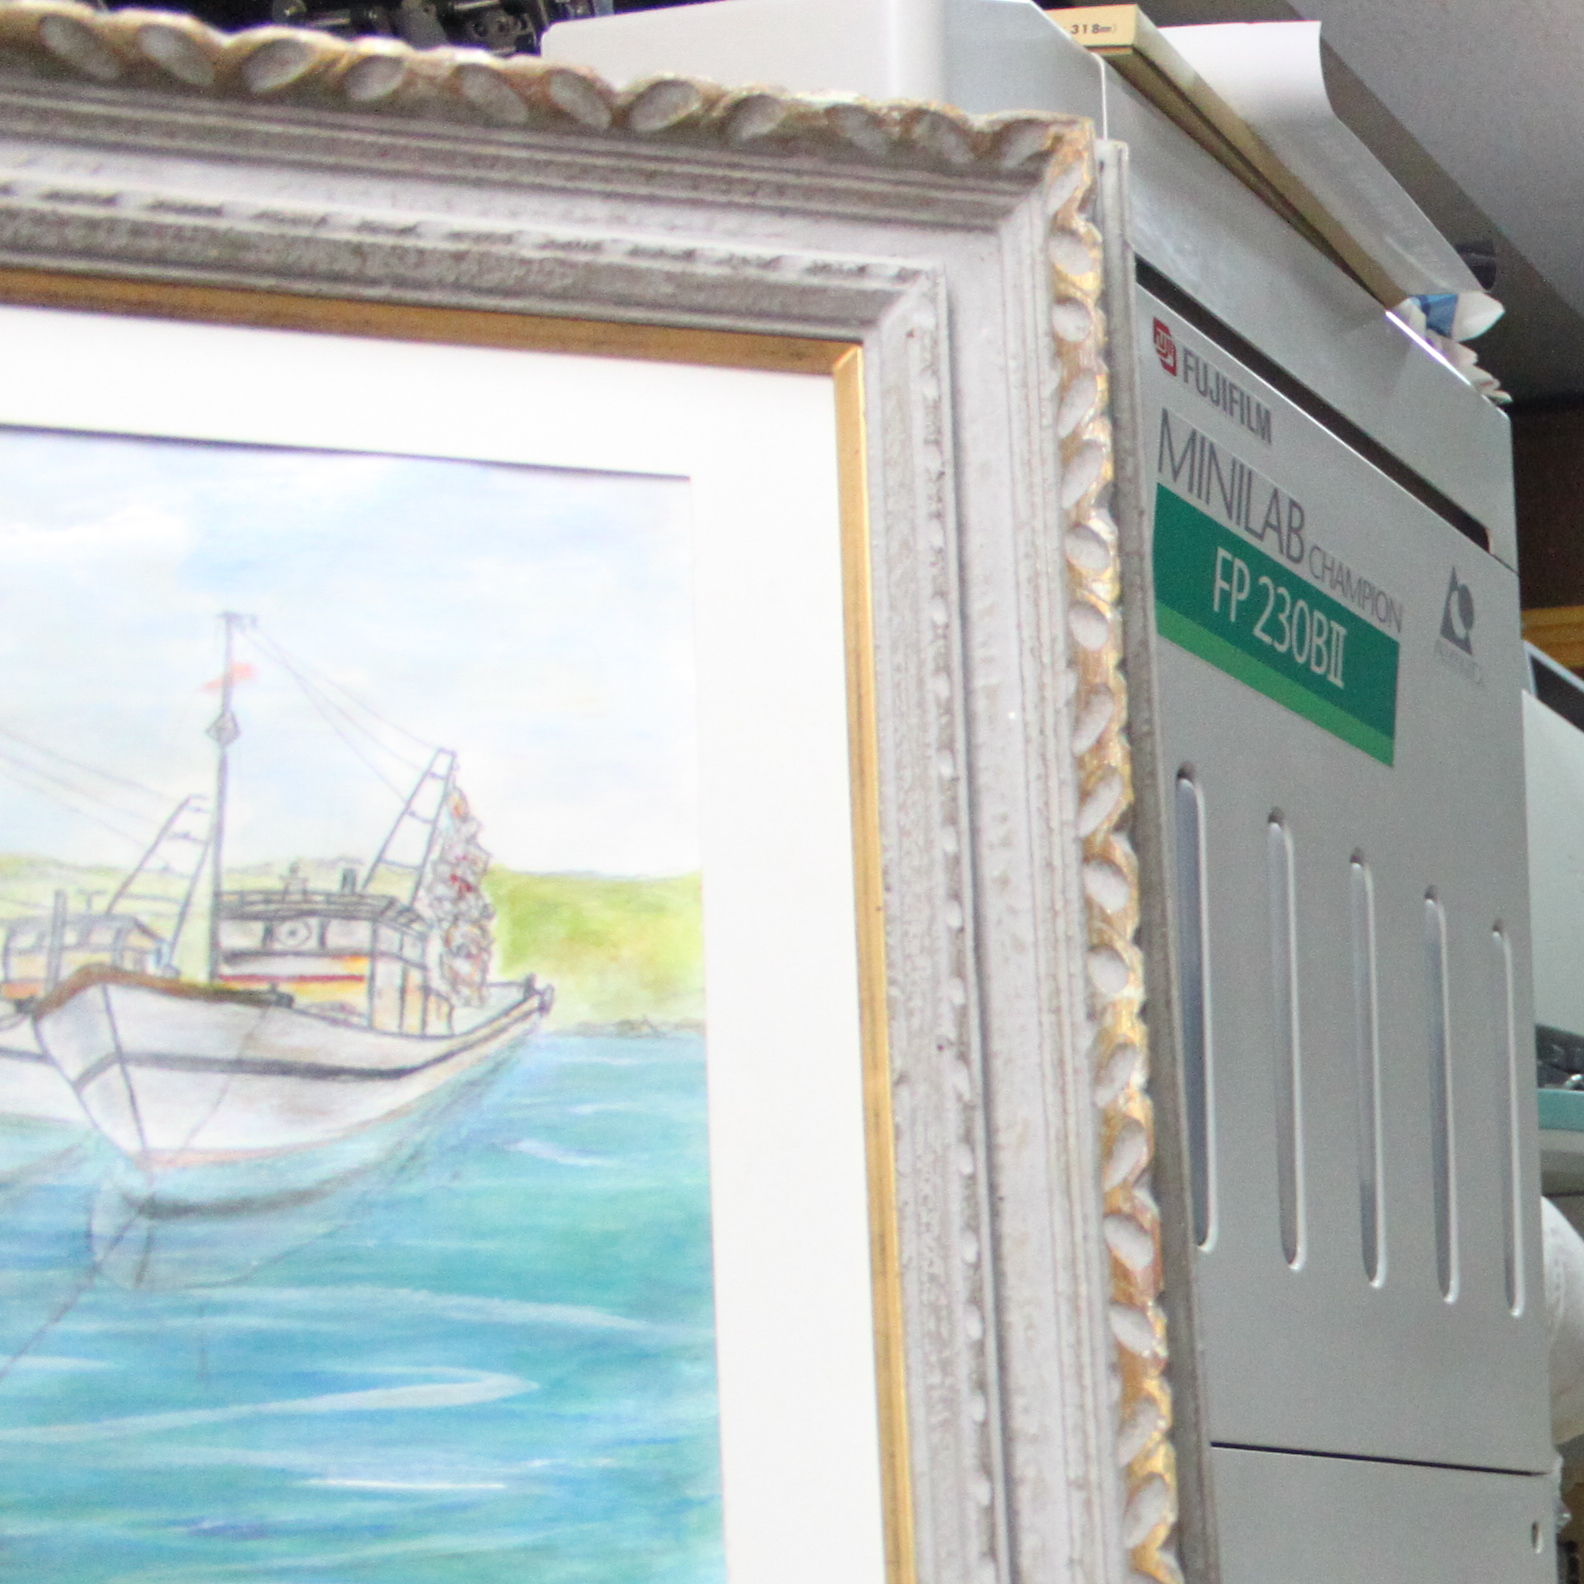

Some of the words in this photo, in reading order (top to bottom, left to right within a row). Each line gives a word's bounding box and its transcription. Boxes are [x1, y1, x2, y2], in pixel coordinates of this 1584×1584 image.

[1183, 346, 1272, 446] FUJIFILM
[1158, 408, 1306, 565] MINILAB
[1309, 543, 1401, 635] CHAMPION
[1213, 547, 1251, 622] FP
